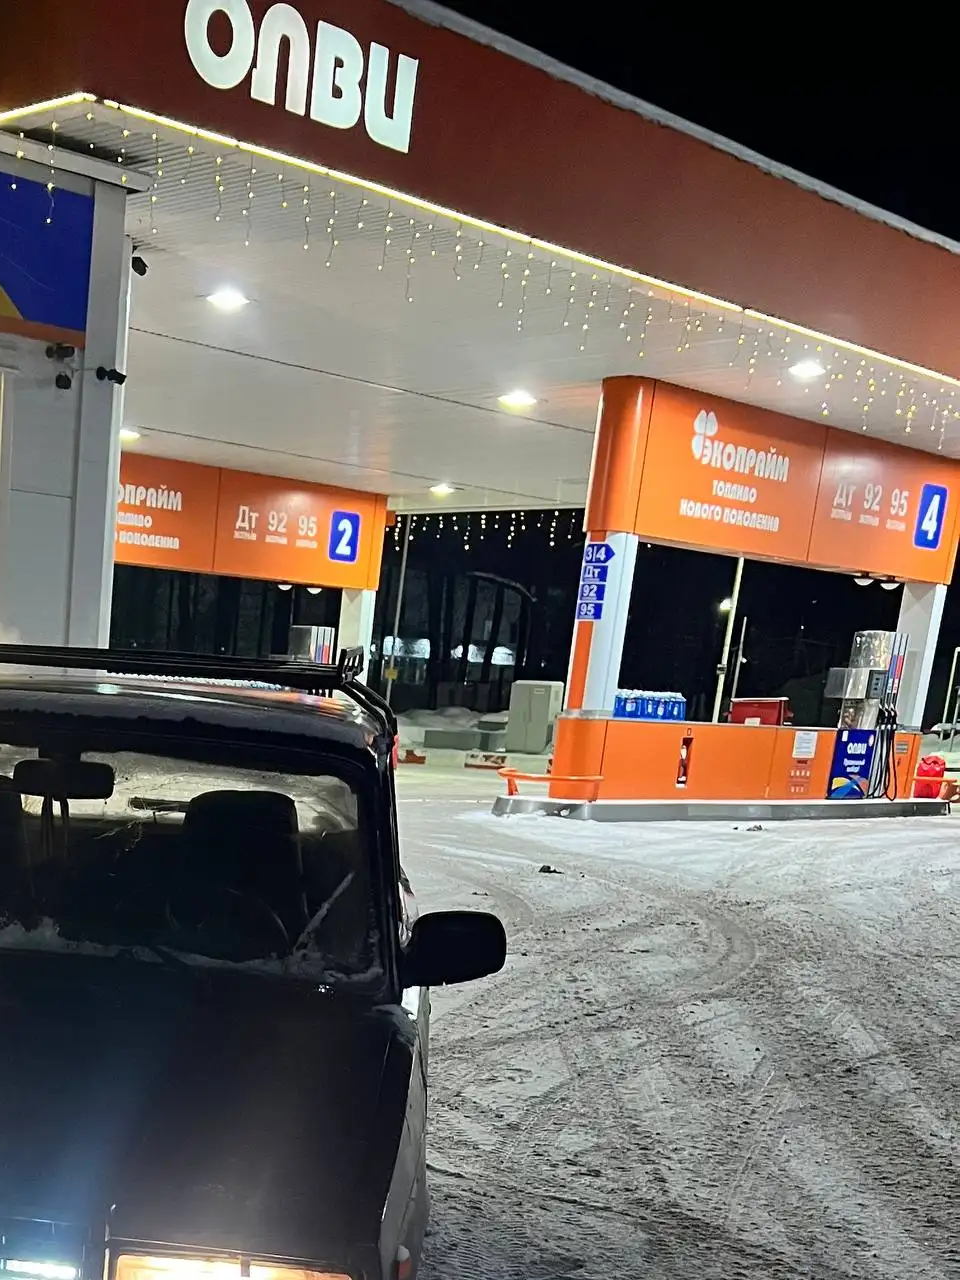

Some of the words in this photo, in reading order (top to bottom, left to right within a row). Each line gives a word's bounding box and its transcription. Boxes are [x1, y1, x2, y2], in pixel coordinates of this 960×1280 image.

[701, 438, 789, 482] ЭКОПРАЙМ
[712, 480, 757, 503] ТОПЛИВО
[864, 484, 882, 511] 92
[890, 488, 909, 516] 95
[679, 499, 722, 521] НОВОГО
[921, 494, 940, 540] 4
[268, 511, 287, 533] 92
[298, 515, 317, 537] 95
[335, 518, 353, 555] 2
[582, 585, 597, 597] 92
[580, 604, 595, 616] 95
